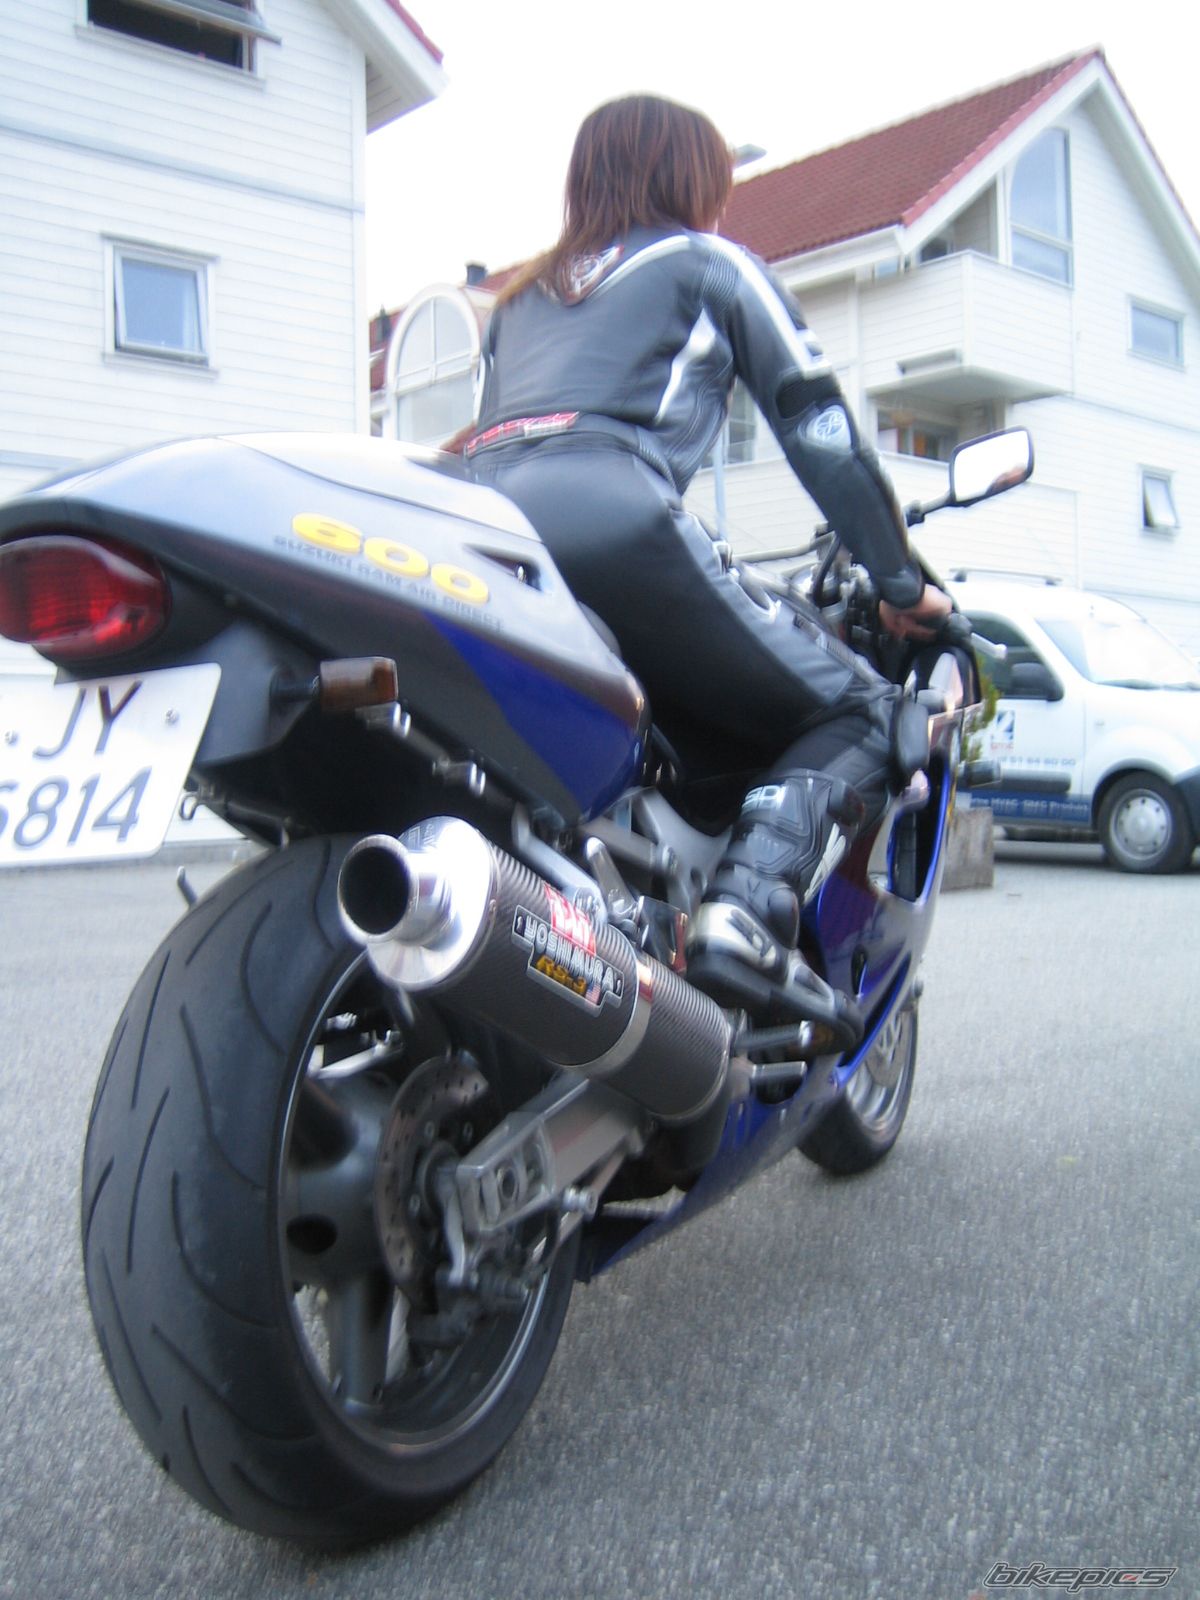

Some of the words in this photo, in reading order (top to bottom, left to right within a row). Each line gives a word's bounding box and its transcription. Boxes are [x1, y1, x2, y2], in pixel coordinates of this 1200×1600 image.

[273, 535, 351, 568] SUZUKI
[292, 512, 488, 607] 600
[33, 680, 143, 760] JY
[524, 915, 615, 988] YOSHIMURA
